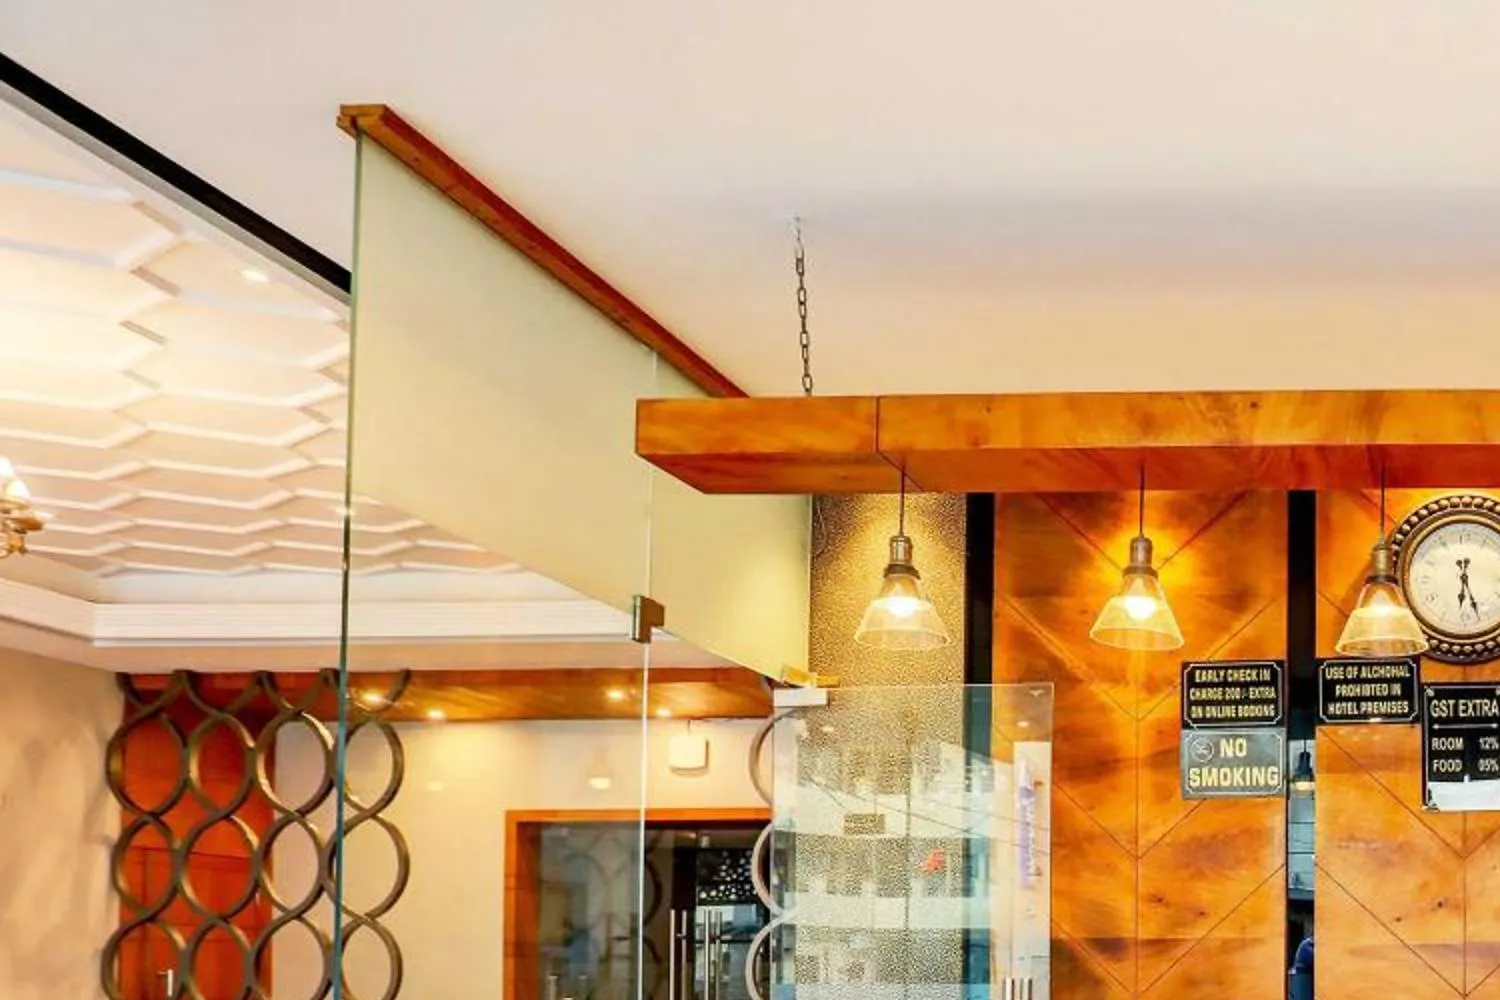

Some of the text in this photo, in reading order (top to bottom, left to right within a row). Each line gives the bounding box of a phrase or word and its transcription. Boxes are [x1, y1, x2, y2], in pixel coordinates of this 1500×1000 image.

[1195, 668, 1271, 683] EARLY CHECK IN
[1325, 667, 1344, 679] USE
[1345, 667, 1358, 679] OF
[1189, 687, 1223, 700] CHARGE
[1249, 686, 1277, 699] EXTRA
[1390, 683, 1401, 696] IN
[1190, 704, 1275, 719] ON ONLINE BOOKING
[1327, 701, 1409, 715] HOTEL PREMISES
[1430, 698, 1500, 717] GST EXTRA
[1220, 737, 1248, 758] NO
[1431, 737, 1464, 751] ROOM
[1432, 758, 1463, 773] FOOD
[1188, 764, 1279, 788] SMOKING
